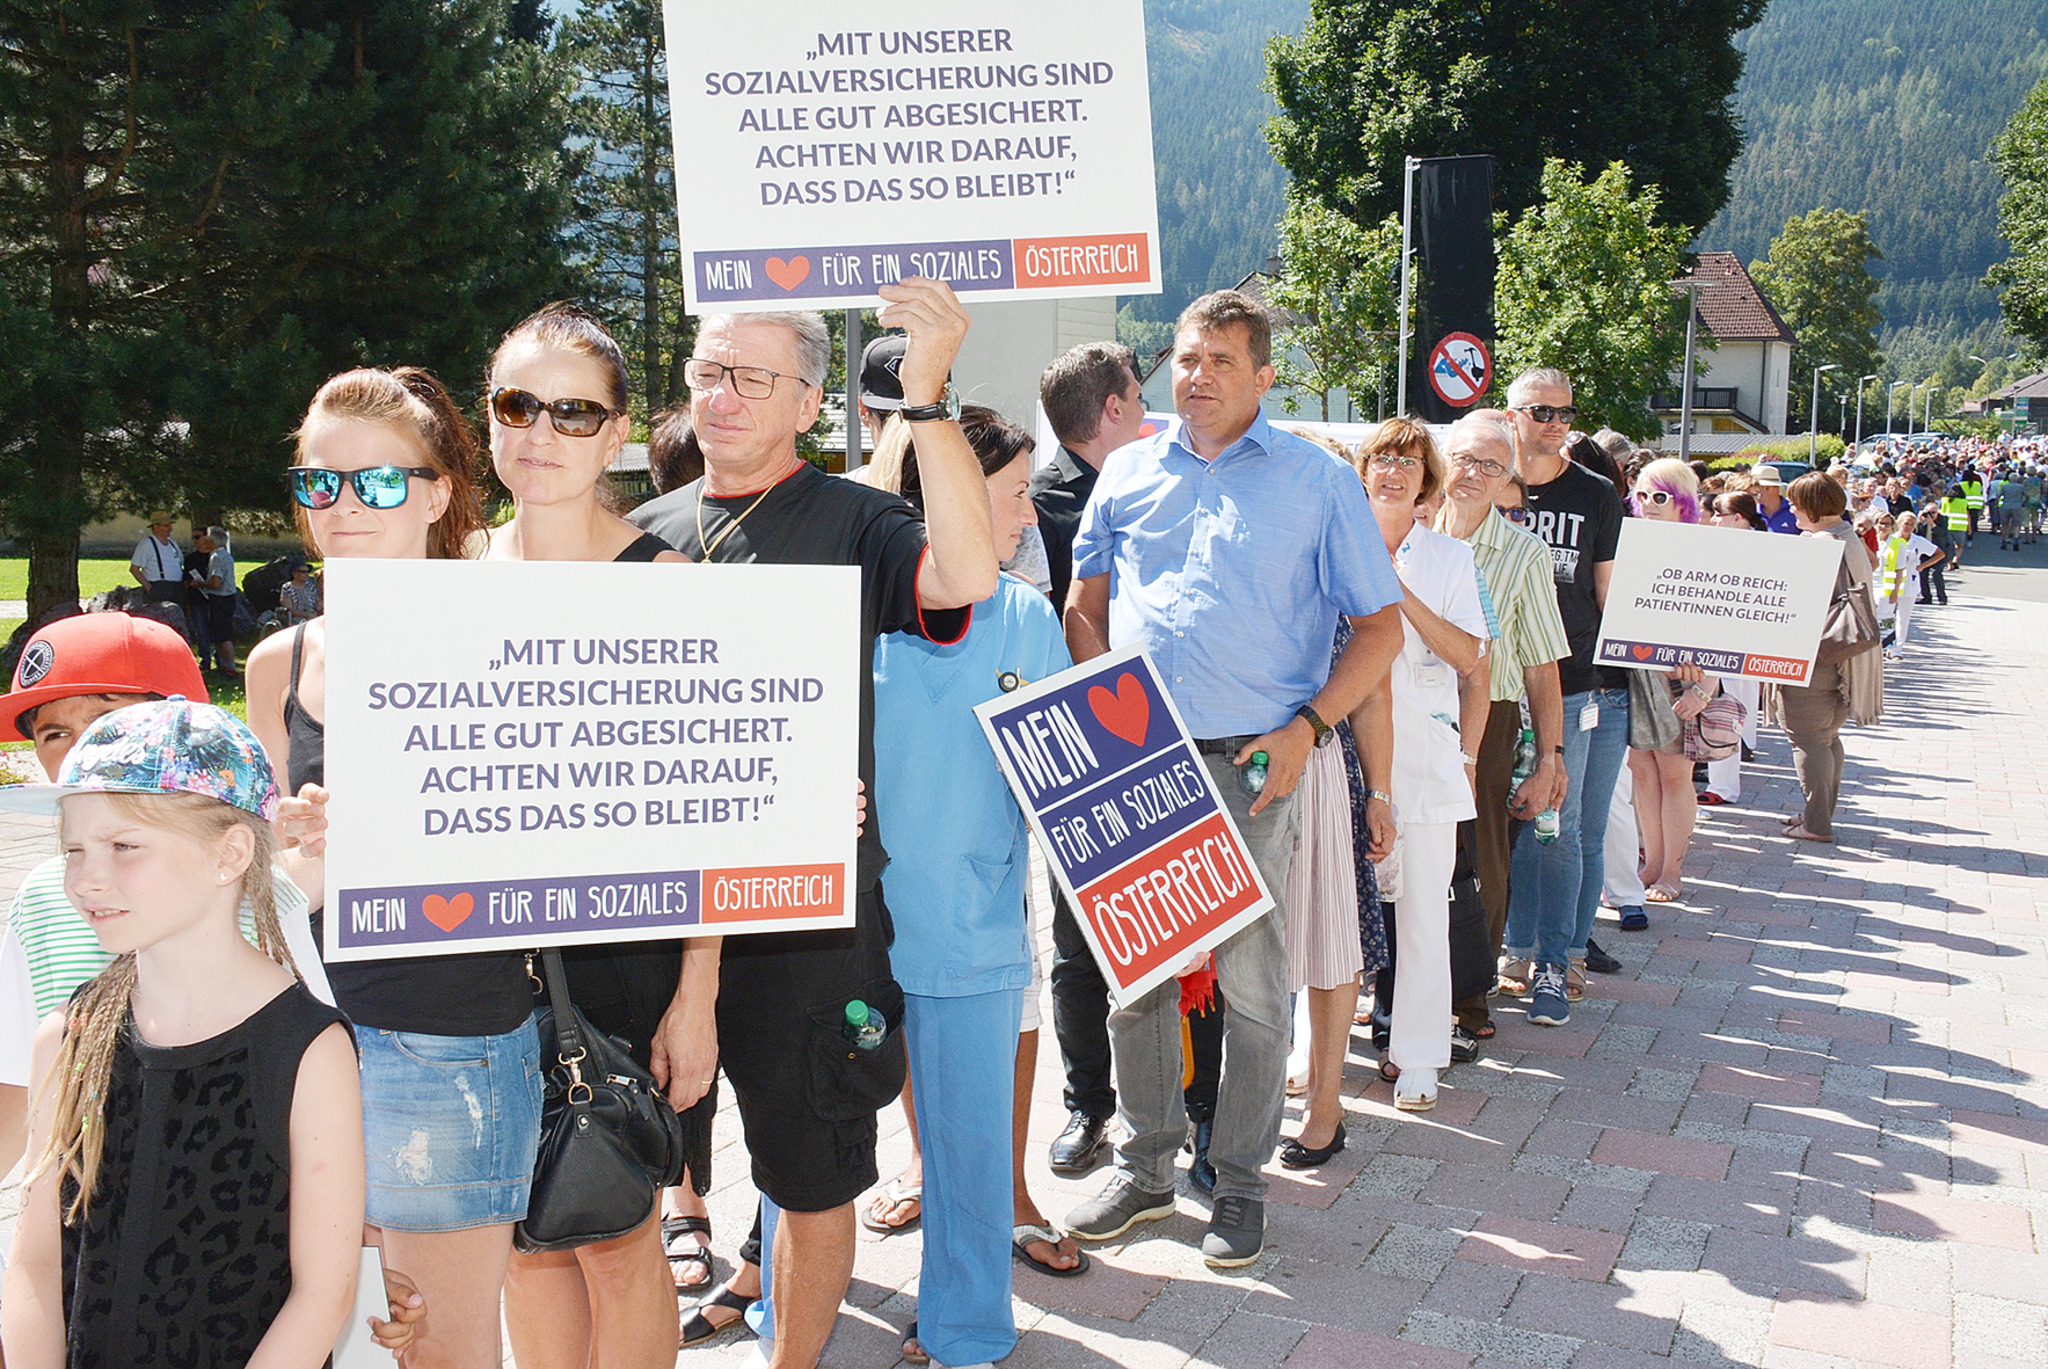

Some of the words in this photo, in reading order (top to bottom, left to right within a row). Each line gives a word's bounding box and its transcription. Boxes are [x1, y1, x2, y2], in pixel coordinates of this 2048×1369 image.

[807, 33, 872, 60] „MIT
[880, 29, 1013, 54] UNSERER
[706, 65, 1037, 95] SOZIALVERSICHERUNG
[1045, 62, 1113, 86] SIND
[739, 108, 809, 132] ALLE
[816, 106, 876, 129] GUT
[884, 99, 1087, 128] ABGESICHERT.
[756, 143, 876, 168] ACHTEN
[883, 141, 944, 164] WIR
[952, 136, 1076, 162] DARAUF,
[761, 181, 837, 205] DASS
[844, 179, 902, 202] DAS
[910, 177, 948, 200] SO
[706, 260, 752, 290] MEIN
[822, 256, 862, 285] FÜR
[872, 254, 901, 284] EIN
[911, 249, 1002, 281] SOZIALES
[1026, 244, 1138, 277] ÖSTERREICH
[1652, 583, 1675, 595] ICH
[1678, 586, 1751, 603] BEHANDLE
[1753, 595, 1786, 607] ALLE
[1657, 569, 1682, 579] „OB
[1685, 571, 1717, 583] ARM
[1720, 575, 1740, 586] OB
[1743, 577, 1787, 591] REICH:
[1635, 598, 1733, 617] PATIENTINNEN
[489, 640, 565, 670] „MIT
[574, 639, 719, 664] UNSERER
[1604, 643, 1627, 657] MEIN
[1655, 647, 1675, 662] FÜR
[1678, 650, 1693, 664] EIN
[1696, 652, 1739, 669] SOZIALES
[1748, 656, 1803, 676] ÖSTERREICH
[369, 679, 742, 709] SOZIALVERSICHERUNG
[751, 678, 823, 703] SIND
[404, 724, 485, 751] ALLE
[494, 722, 563, 749] GUT
[571, 718, 792, 747] ABGESICHERT.
[1001, 699, 1099, 799] MEIN
[420, 764, 559, 793] ACHTEN
[568, 762, 635, 787] WIR
[644, 757, 777, 785] DARAUF,
[425, 806, 511, 835] DASS
[521, 803, 585, 831] DAS
[593, 802, 636, 827] SO
[1051, 816, 1102, 869] FÜR
[1095, 800, 1131, 848] EIN
[1123, 759, 1205, 830] SOZIALES
[352, 898, 405, 933] MEIN
[489, 891, 532, 924] FÜR
[546, 888, 576, 921] EIN
[588, 882, 687, 918] SOZIALES
[714, 875, 832, 910] ÖSTERREICH
[1091, 830, 1251, 967] ÖSTERREICH
